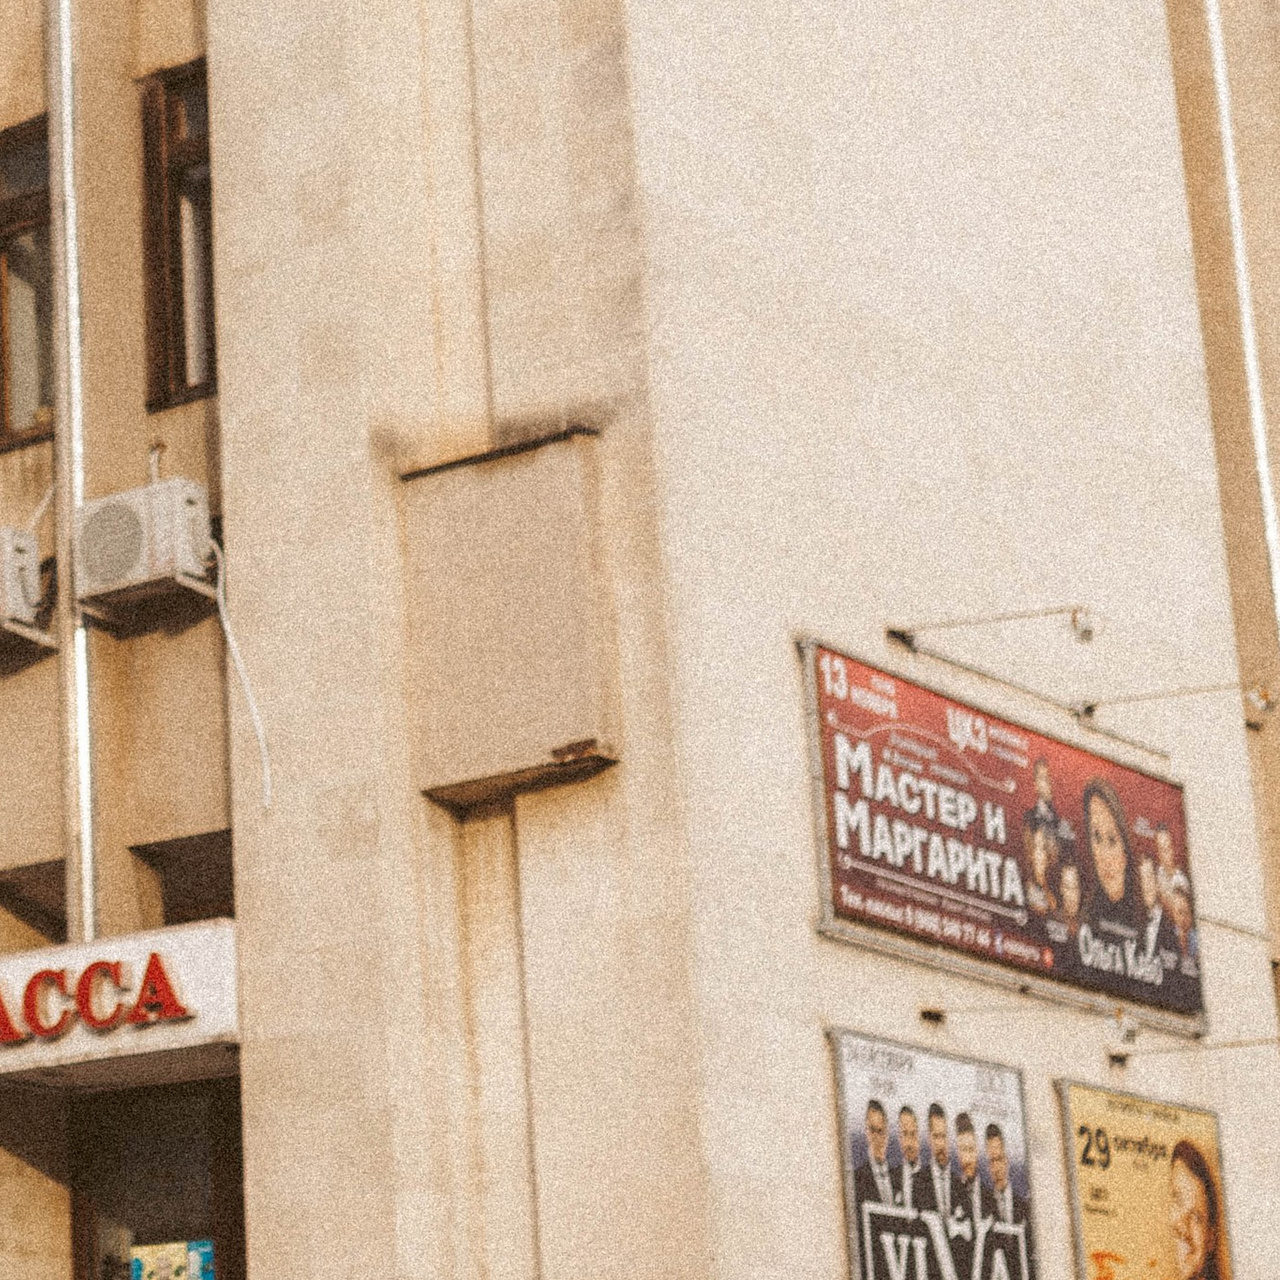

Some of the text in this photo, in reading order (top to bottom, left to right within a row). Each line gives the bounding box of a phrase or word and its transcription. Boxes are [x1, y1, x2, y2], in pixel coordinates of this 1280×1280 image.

[820, 653, 848, 701] 13
[834, 732, 977, 831] МАСТЕР
[983, 801, 1007, 845] И
[834, 790, 1026, 907] МАРГАРИТА
[1077, 1124, 1111, 1170] 29
